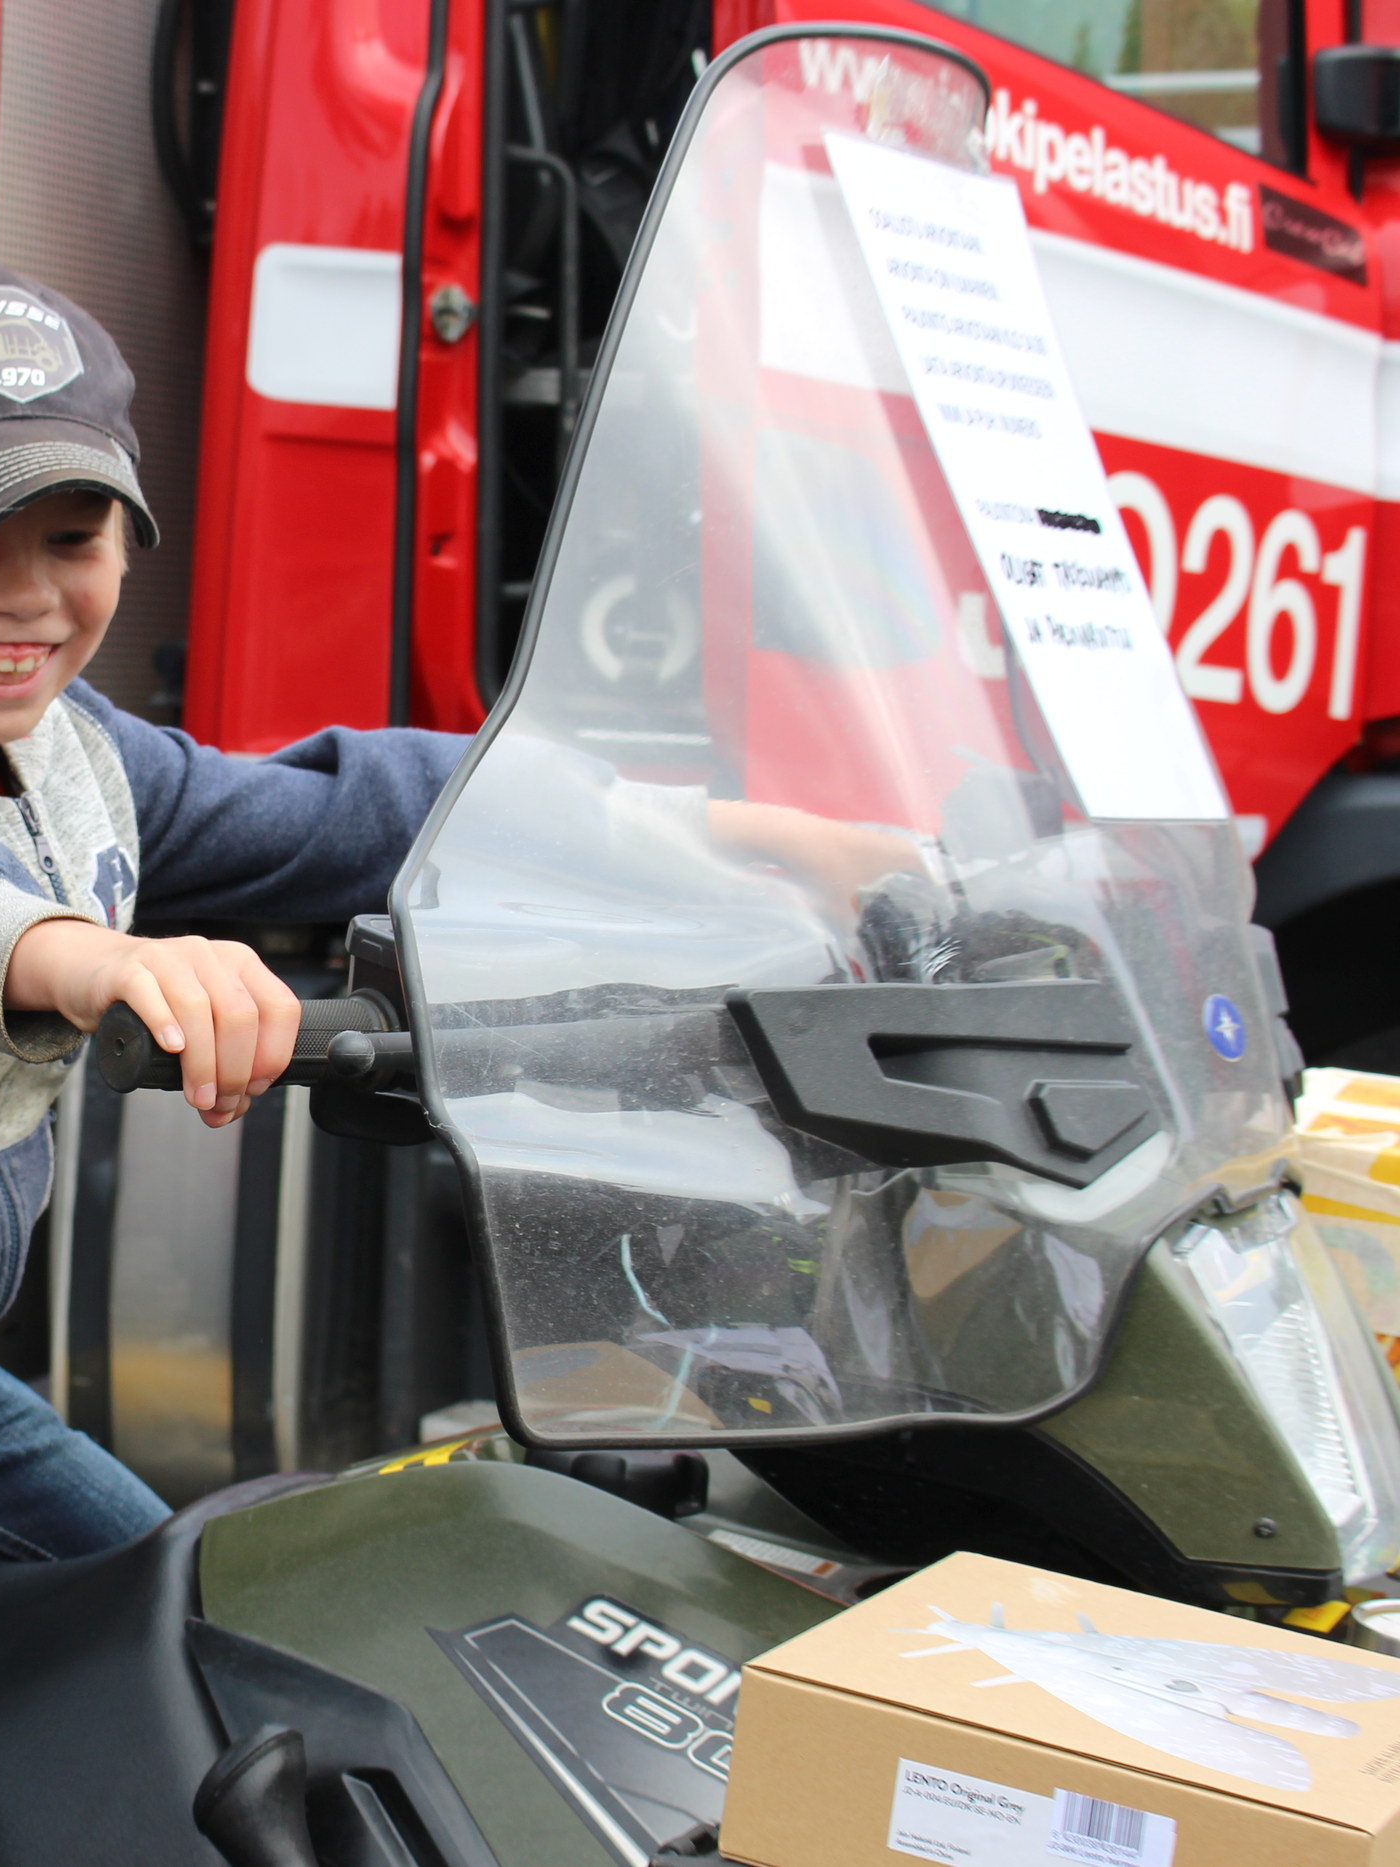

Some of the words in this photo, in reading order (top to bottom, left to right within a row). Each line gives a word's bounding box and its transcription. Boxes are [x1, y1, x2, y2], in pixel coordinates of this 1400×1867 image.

[904, 1769, 948, 1792] LENTO
[950, 1782, 996, 1805] Original
[996, 1794, 1025, 1815] Grey
